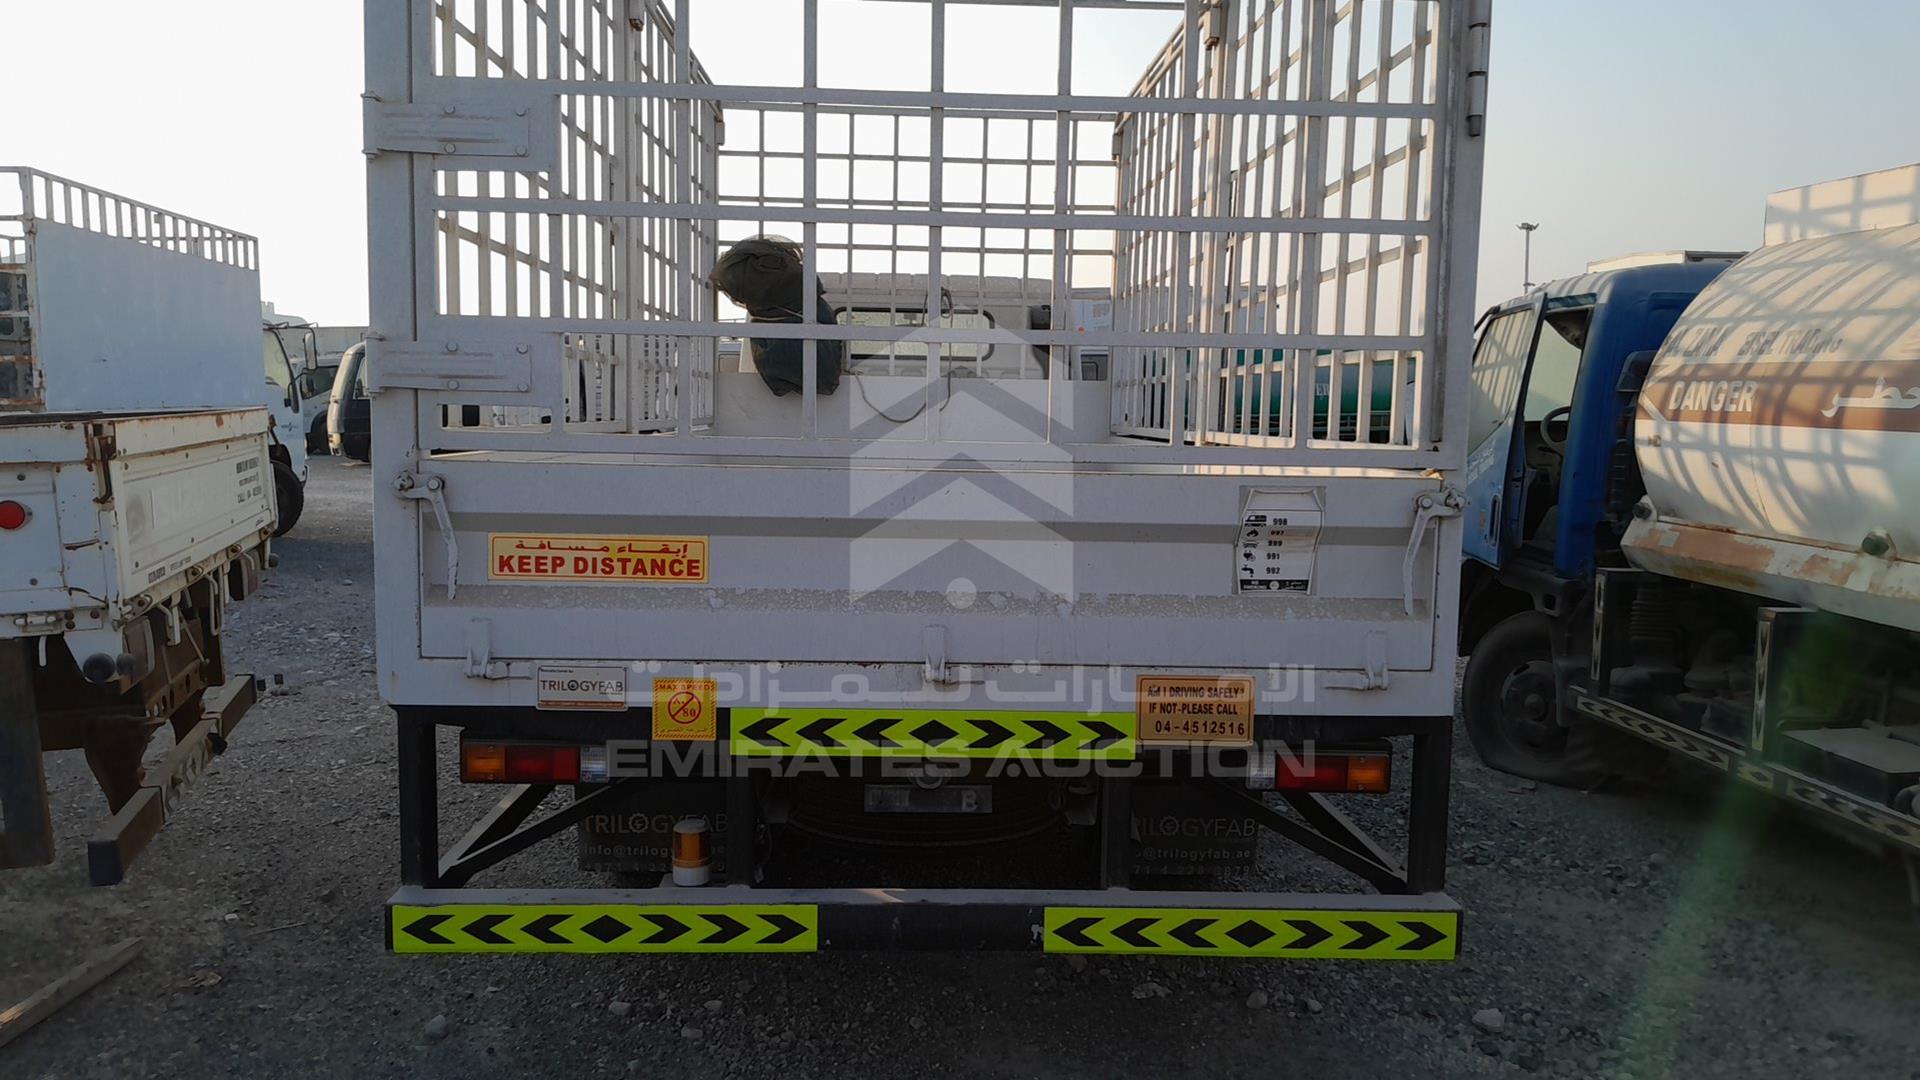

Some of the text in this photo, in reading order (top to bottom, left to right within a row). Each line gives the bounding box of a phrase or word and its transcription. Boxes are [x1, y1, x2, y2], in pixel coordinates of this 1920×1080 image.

[1668, 380, 1759, 412] DANGER
[515, 540, 609, 553] مسافة
[499, 555, 701, 577] KEEP DISTANCE
[540, 679, 624, 692] TRILOGYFAB
[1163, 686, 1166, 697] I
[1169, 686, 1205, 698] DRIVING
[682, 708, 696, 717] 80
[1149, 703, 1157, 714] IF
[1216, 704, 1238, 715] CALL
